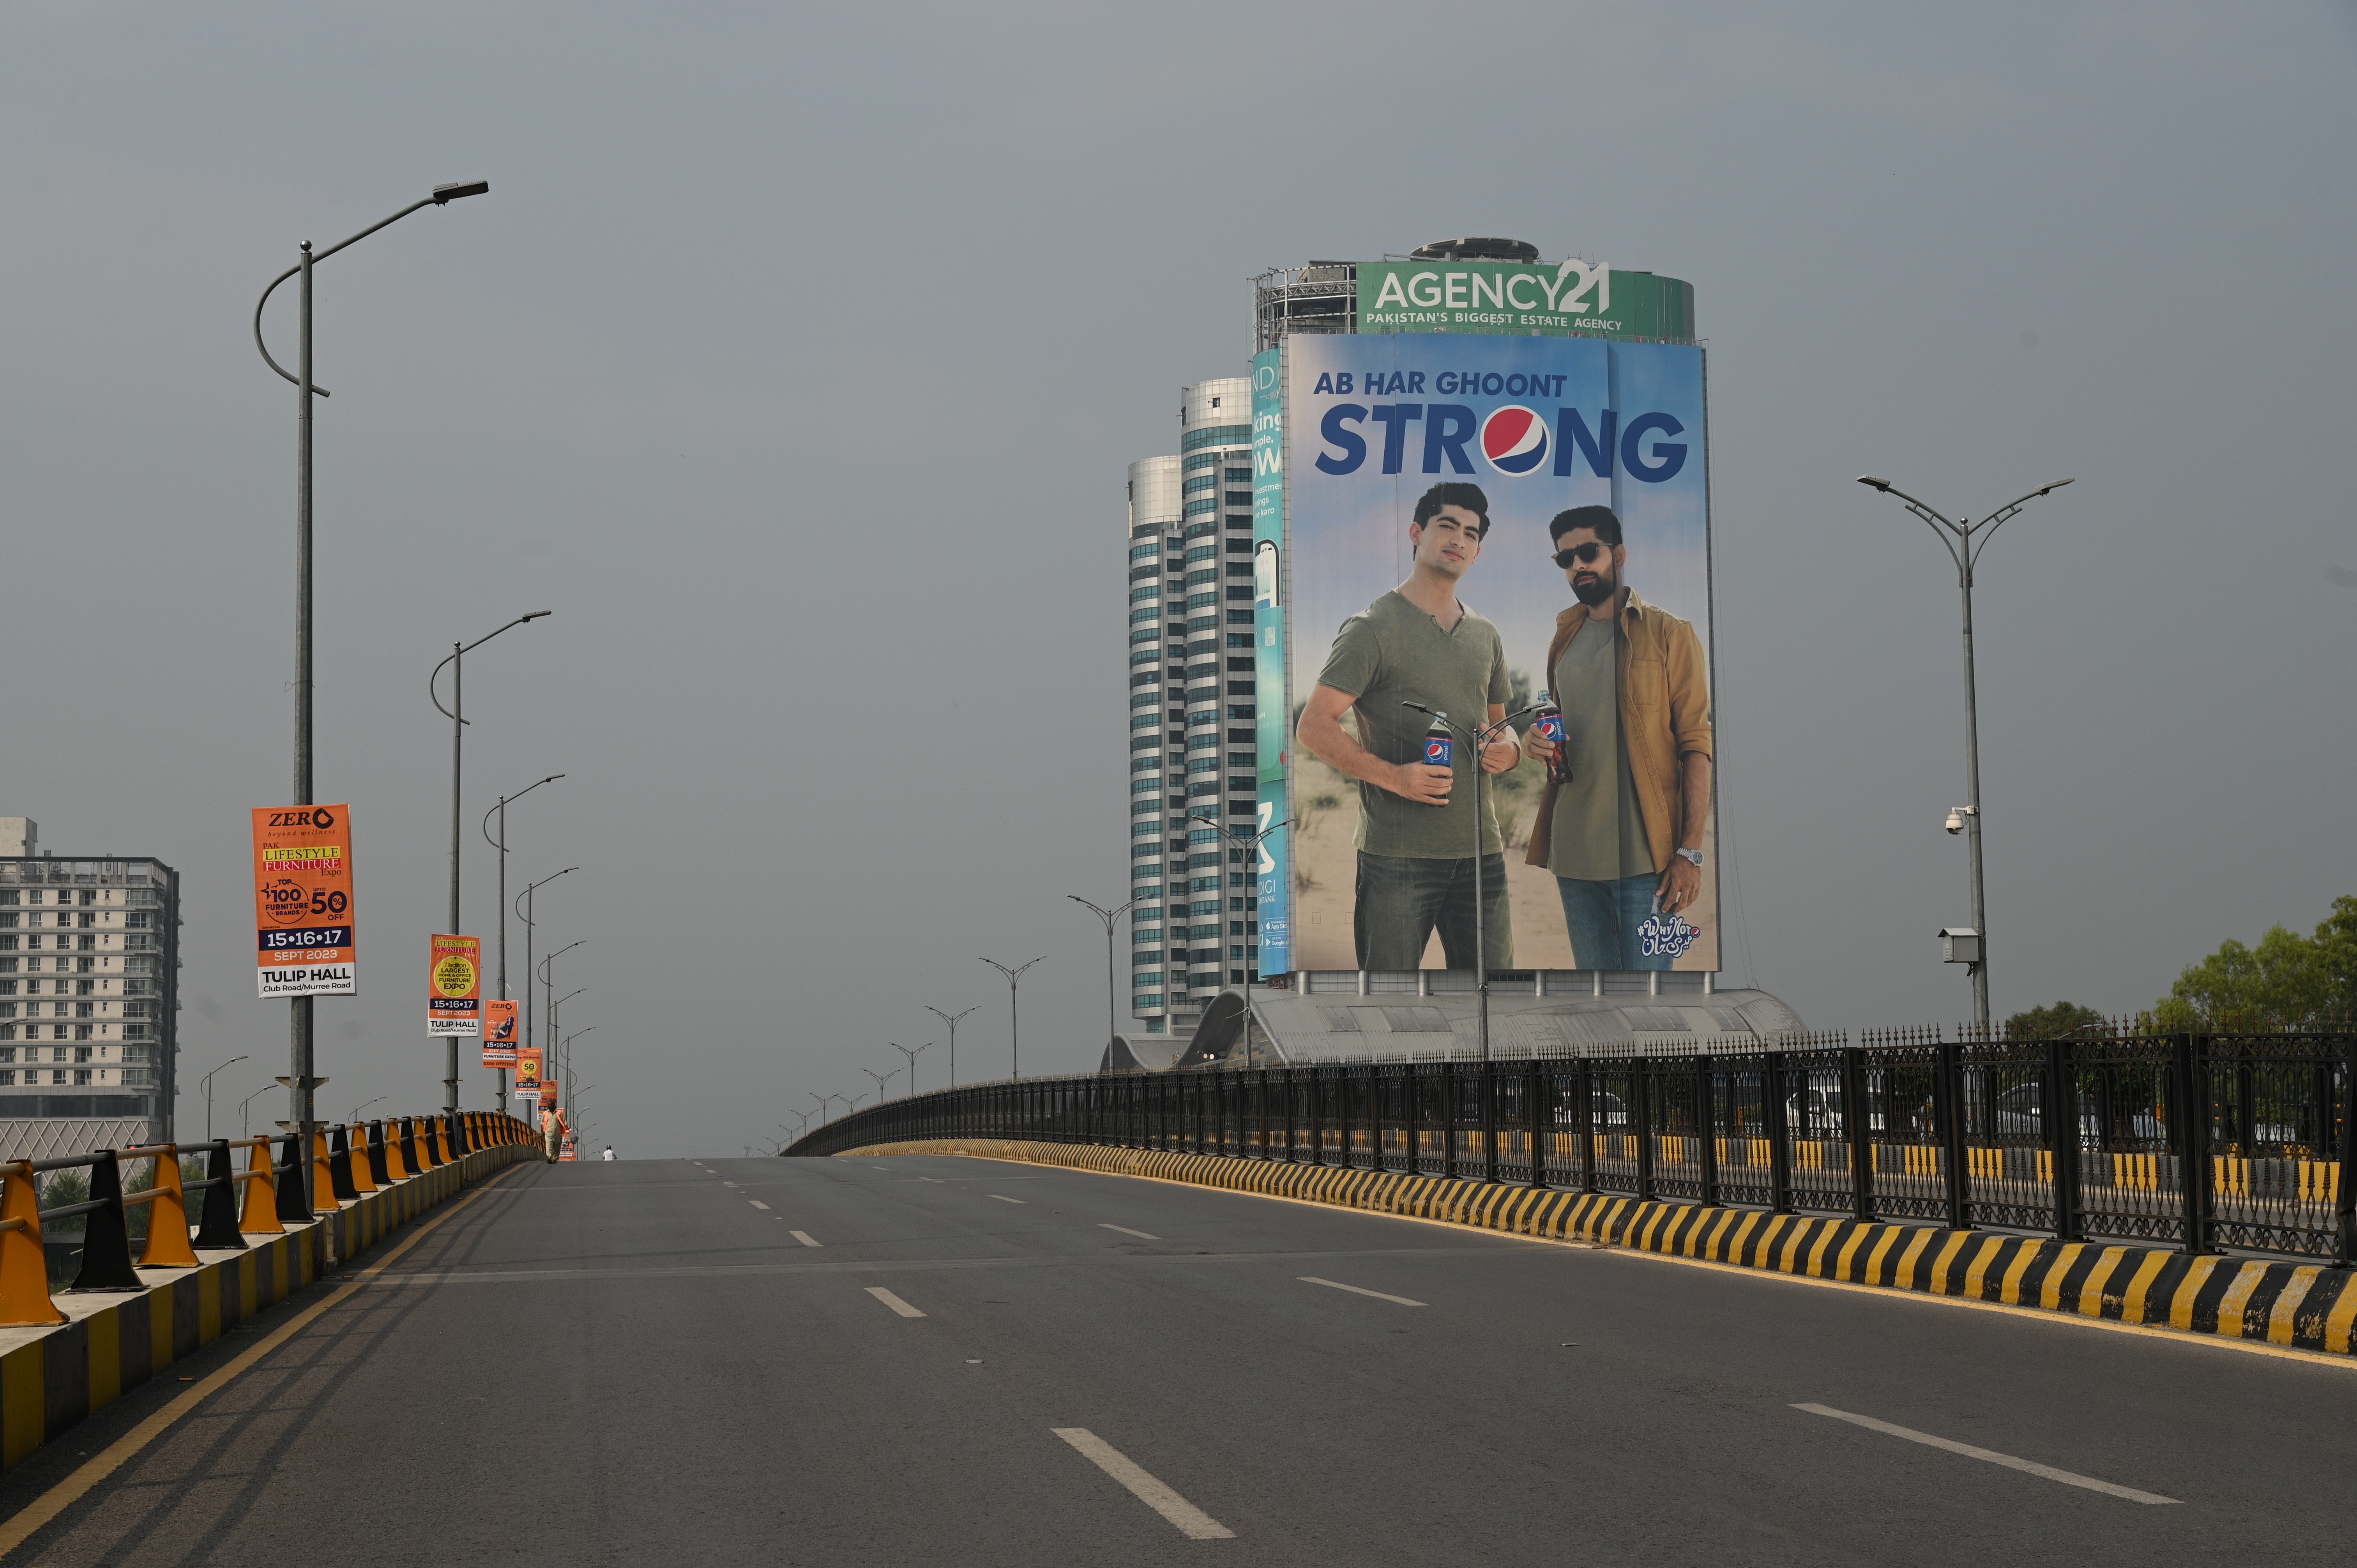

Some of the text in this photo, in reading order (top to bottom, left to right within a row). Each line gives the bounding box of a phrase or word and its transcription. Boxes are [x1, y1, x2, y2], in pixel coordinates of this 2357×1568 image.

[1367, 312, 1622, 330] PAKISTAN'S BIGGEST ESTATE AGENCY
[1313, 371, 1567, 397] AB HAR GHOONT
[1261, 507, 1275, 516] karo
[269, 808, 334, 829] ZERO
[265, 847, 339, 860] LIFESTYLE
[265, 858, 339, 872] FURNITURE
[321, 869, 341, 877] Expo
[271, 888, 301, 902] 100
[265, 902, 309, 911] FURNITURE
[274, 949, 337, 961] SEPT 2023
[262, 968, 351, 983] TULIP HALL
[283, 983, 330, 991] Road/Murree
